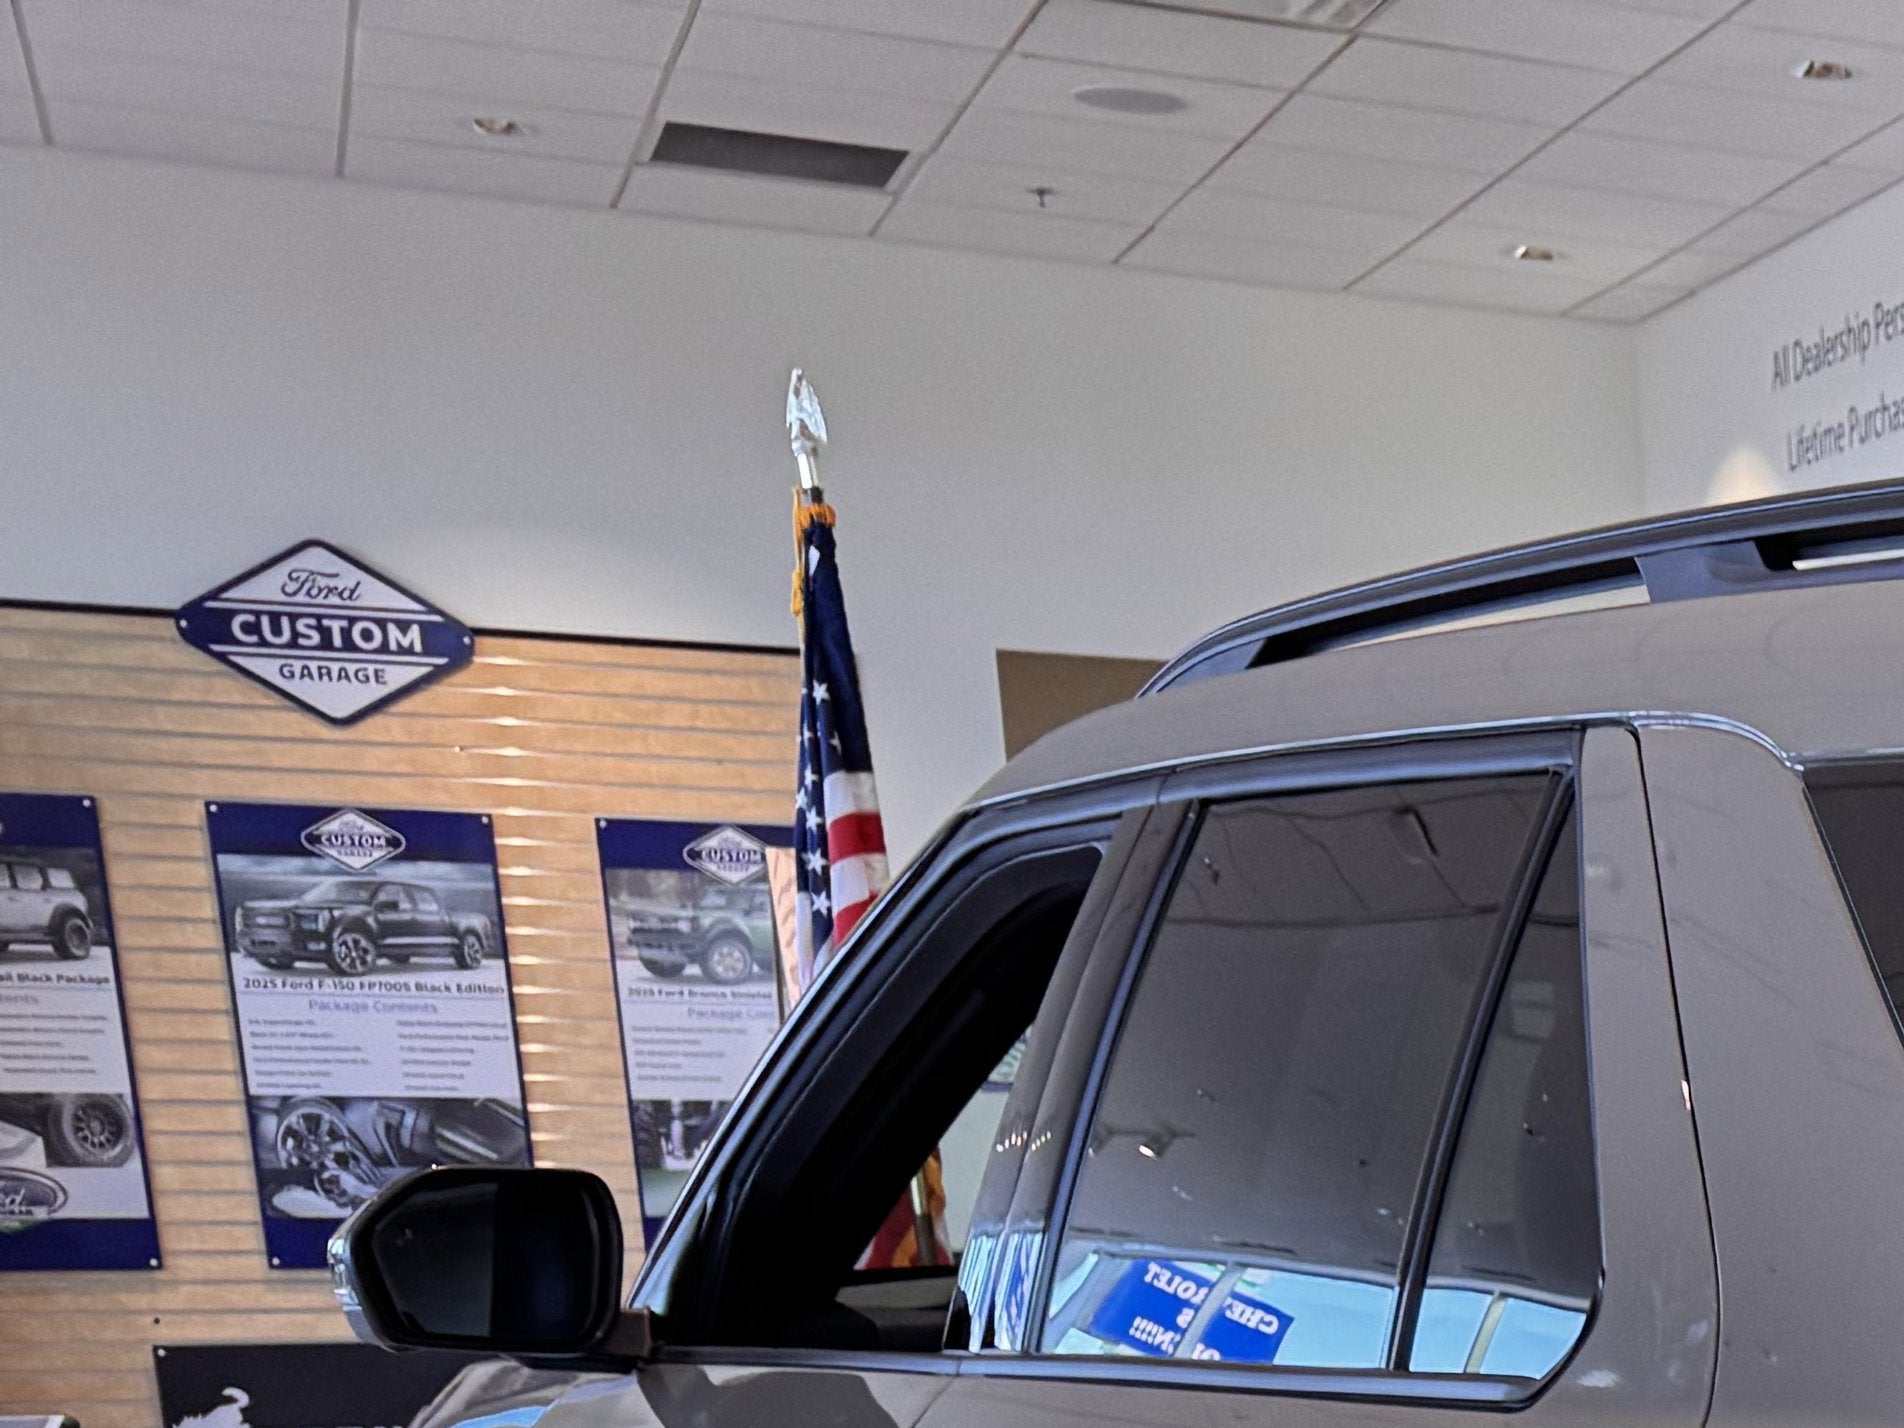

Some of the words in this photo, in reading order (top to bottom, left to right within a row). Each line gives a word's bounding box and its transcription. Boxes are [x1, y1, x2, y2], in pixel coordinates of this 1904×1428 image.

[1772, 344, 1790, 392] All
[1793, 312, 1870, 382] Dealership
[1786, 416, 1845, 472] Lifetime
[280, 568, 362, 602] Ford
[230, 613, 423, 654] CUSTOM
[278, 663, 388, 686] GARAGE
[320, 833, 387, 848] CUSTOM
[243, 977, 278, 989] 2025
